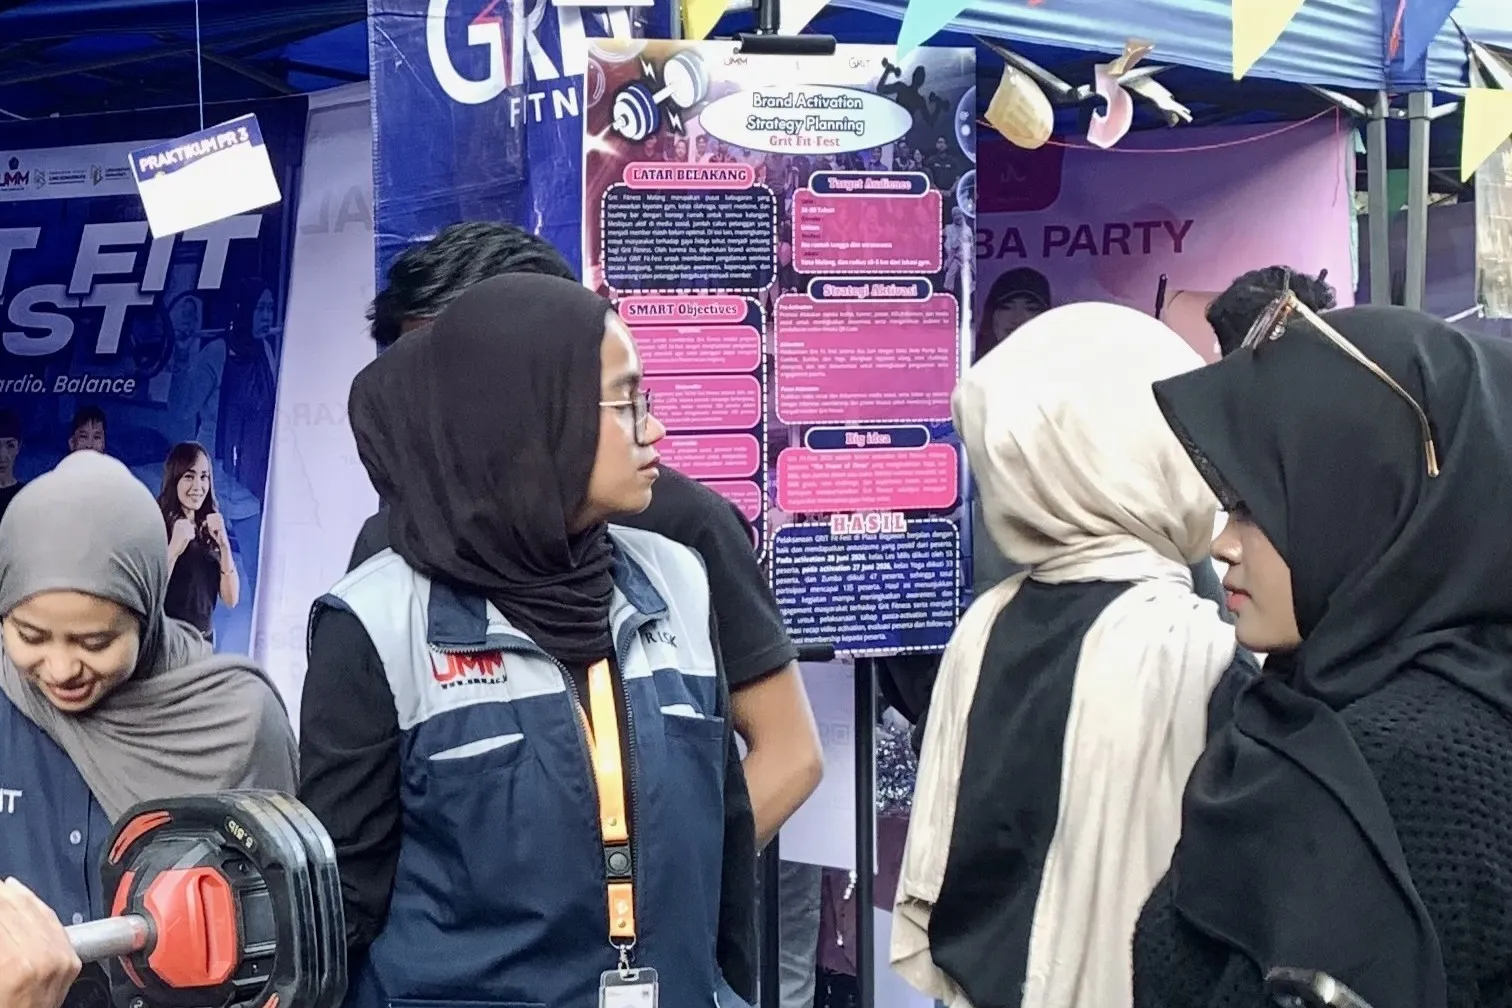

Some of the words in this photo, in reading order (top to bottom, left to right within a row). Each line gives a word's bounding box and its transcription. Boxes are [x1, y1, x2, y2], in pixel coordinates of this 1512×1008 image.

[752, 92, 794, 108] Brand
[795, 93, 863, 109] Activation
[746, 115, 804, 135] Strategy
[805, 116, 865, 136] Planning
[769, 136, 793, 147] Grit
[139, 135, 218, 173] PRAKTIKUM
[633, 168, 673, 182] LATAR
[675, 168, 747, 182] BELAKANG
[1043, 219, 1194, 258] PARTY
[68, 214, 262, 294] FIT
[629, 304, 675, 315] SMART
[678, 303, 738, 317] Objectives
[53, 373, 136, 394] Balance
[831, 512, 907, 534] HASIL
